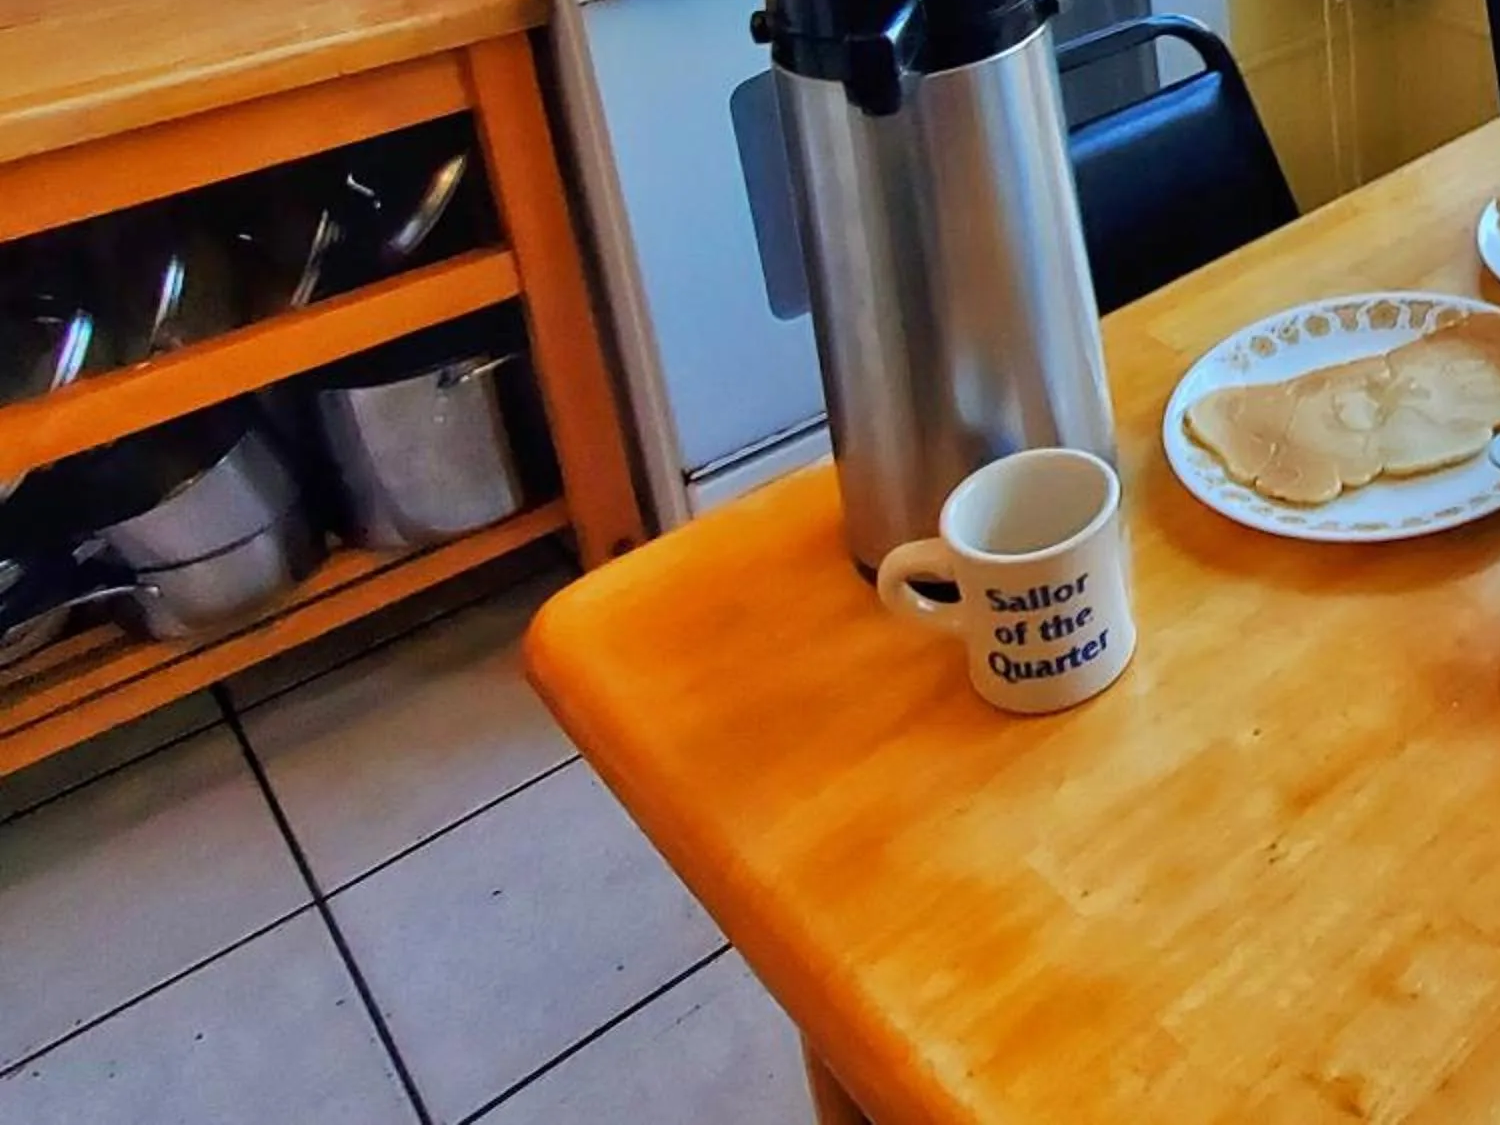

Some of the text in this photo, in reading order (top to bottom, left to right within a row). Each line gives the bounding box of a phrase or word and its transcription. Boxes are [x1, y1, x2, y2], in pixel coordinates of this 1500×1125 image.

[985, 573, 1088, 612] Sailor
[994, 606, 1093, 646] of the
[987, 629, 1110, 683] Quarter
